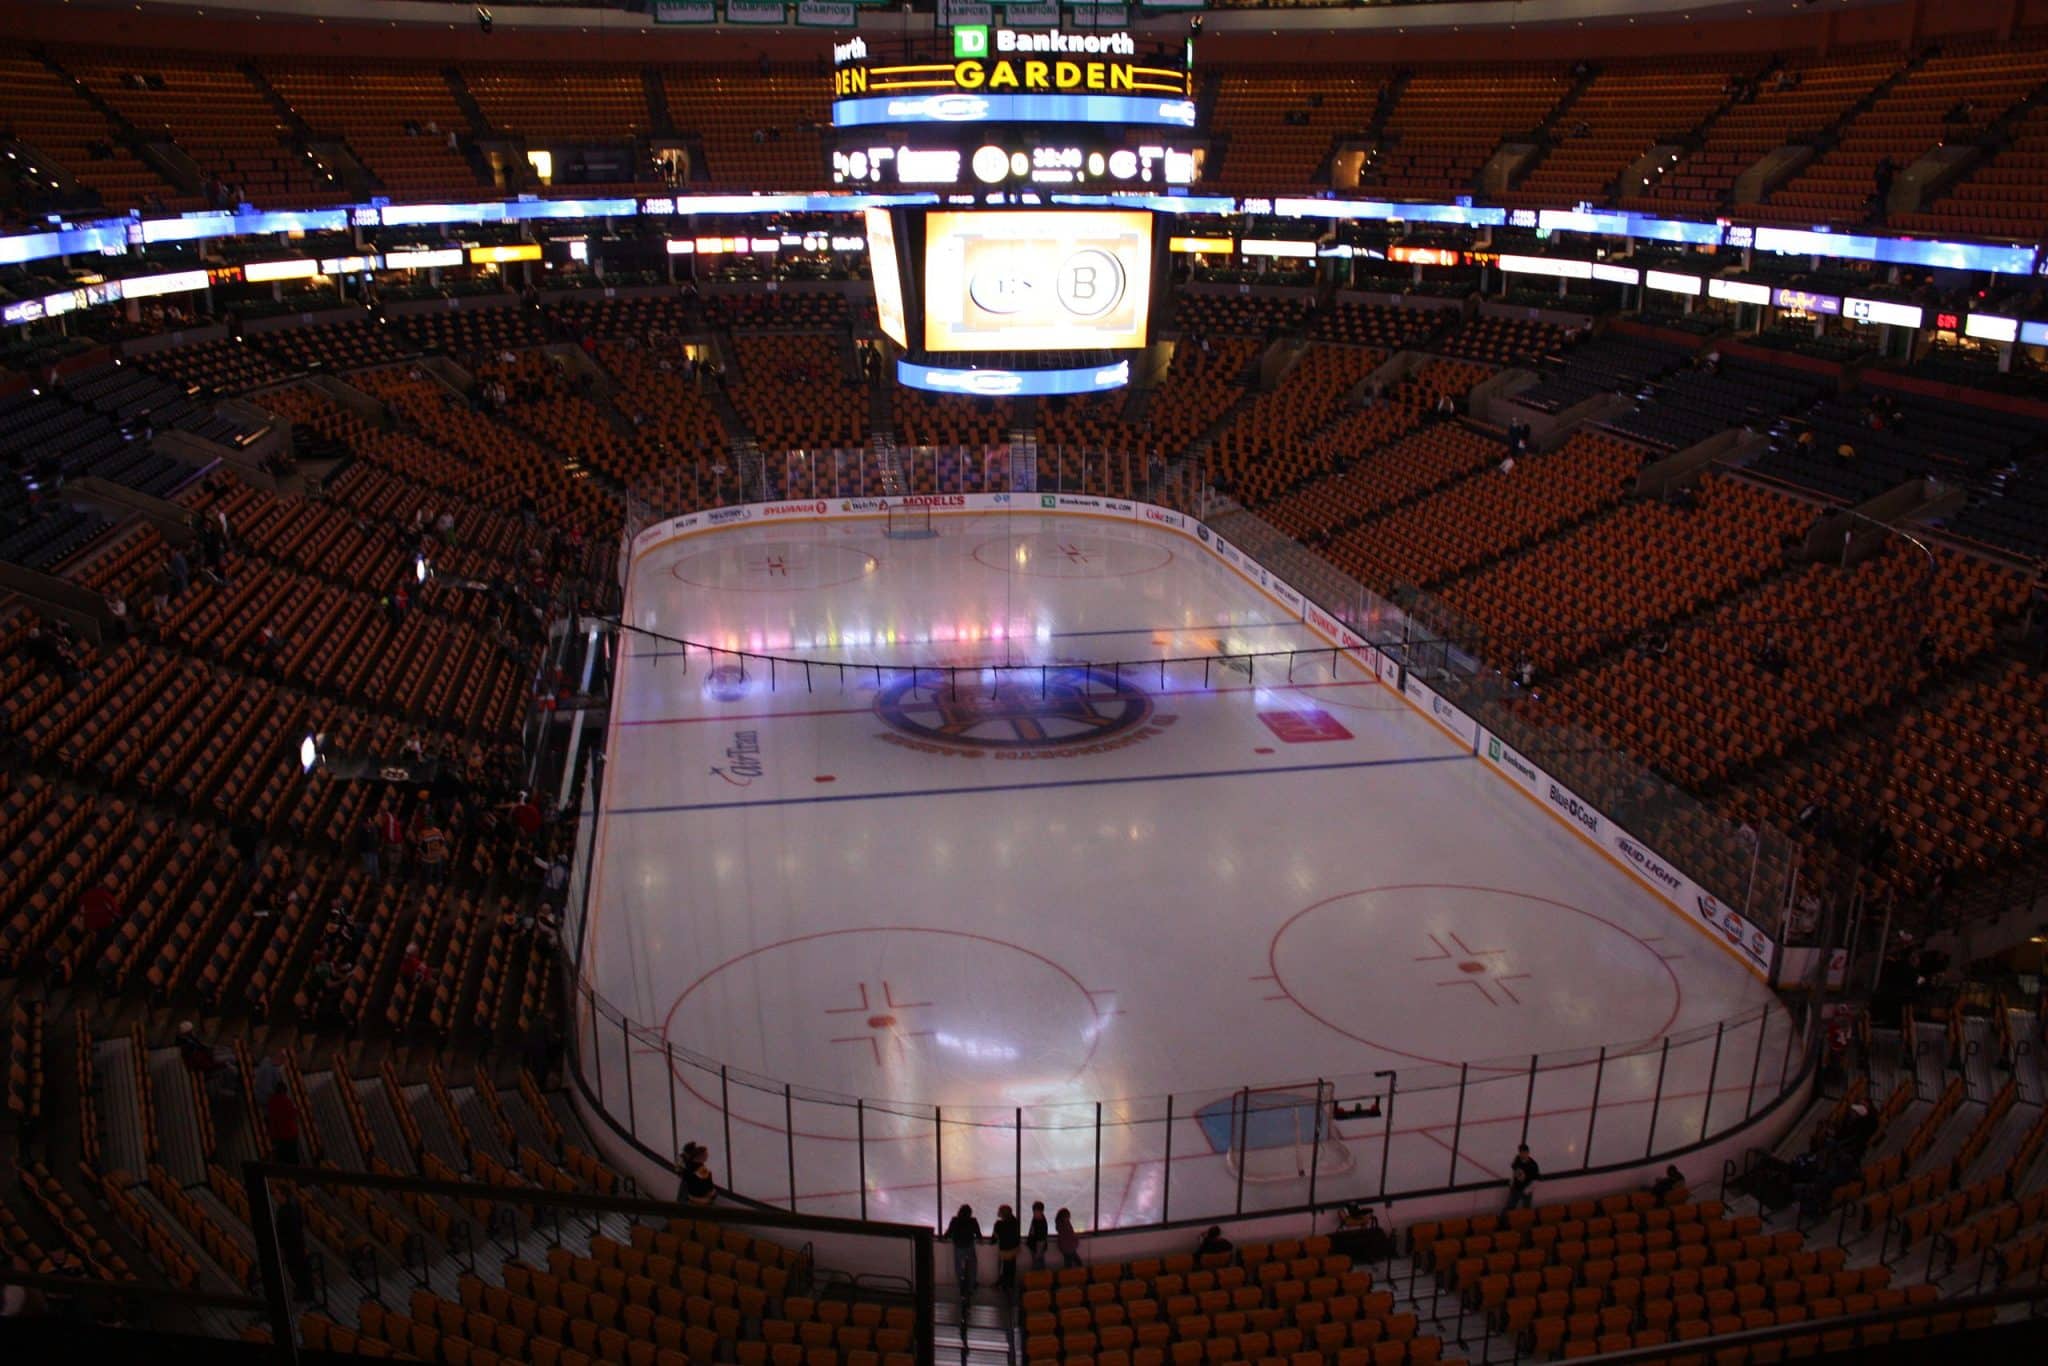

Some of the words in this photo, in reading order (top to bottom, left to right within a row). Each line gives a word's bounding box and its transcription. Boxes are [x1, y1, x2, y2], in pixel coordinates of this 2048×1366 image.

[802, 5, 850, 15] CHAMPIONS
[942, 6, 989, 16] CHAMPIONS
[1008, 5, 1057, 16] CHAMPIONS
[957, 30, 985, 52] TD
[997, 29, 1135, 54] Banknorth
[955, 60, 1134, 88] GARDEN
[835, 66, 866, 95] DEN
[1730, 226, 1752, 238] BUD
[1725, 236, 1753, 247] LIGHT
[903, 495, 965, 506] MODELL'S
[1059, 497, 1100, 507] Banknorth
[763, 505, 815, 516] SYLVANIA
[1503, 749, 1537, 782] Banknorth
[1549, 784, 1570, 812] Blue
[1577, 805, 1598, 833] Coat
[1618, 839, 1645, 863] BUD
[1645, 857, 1682, 889] LIGHT
[1723, 917, 1744, 939] Gulf
